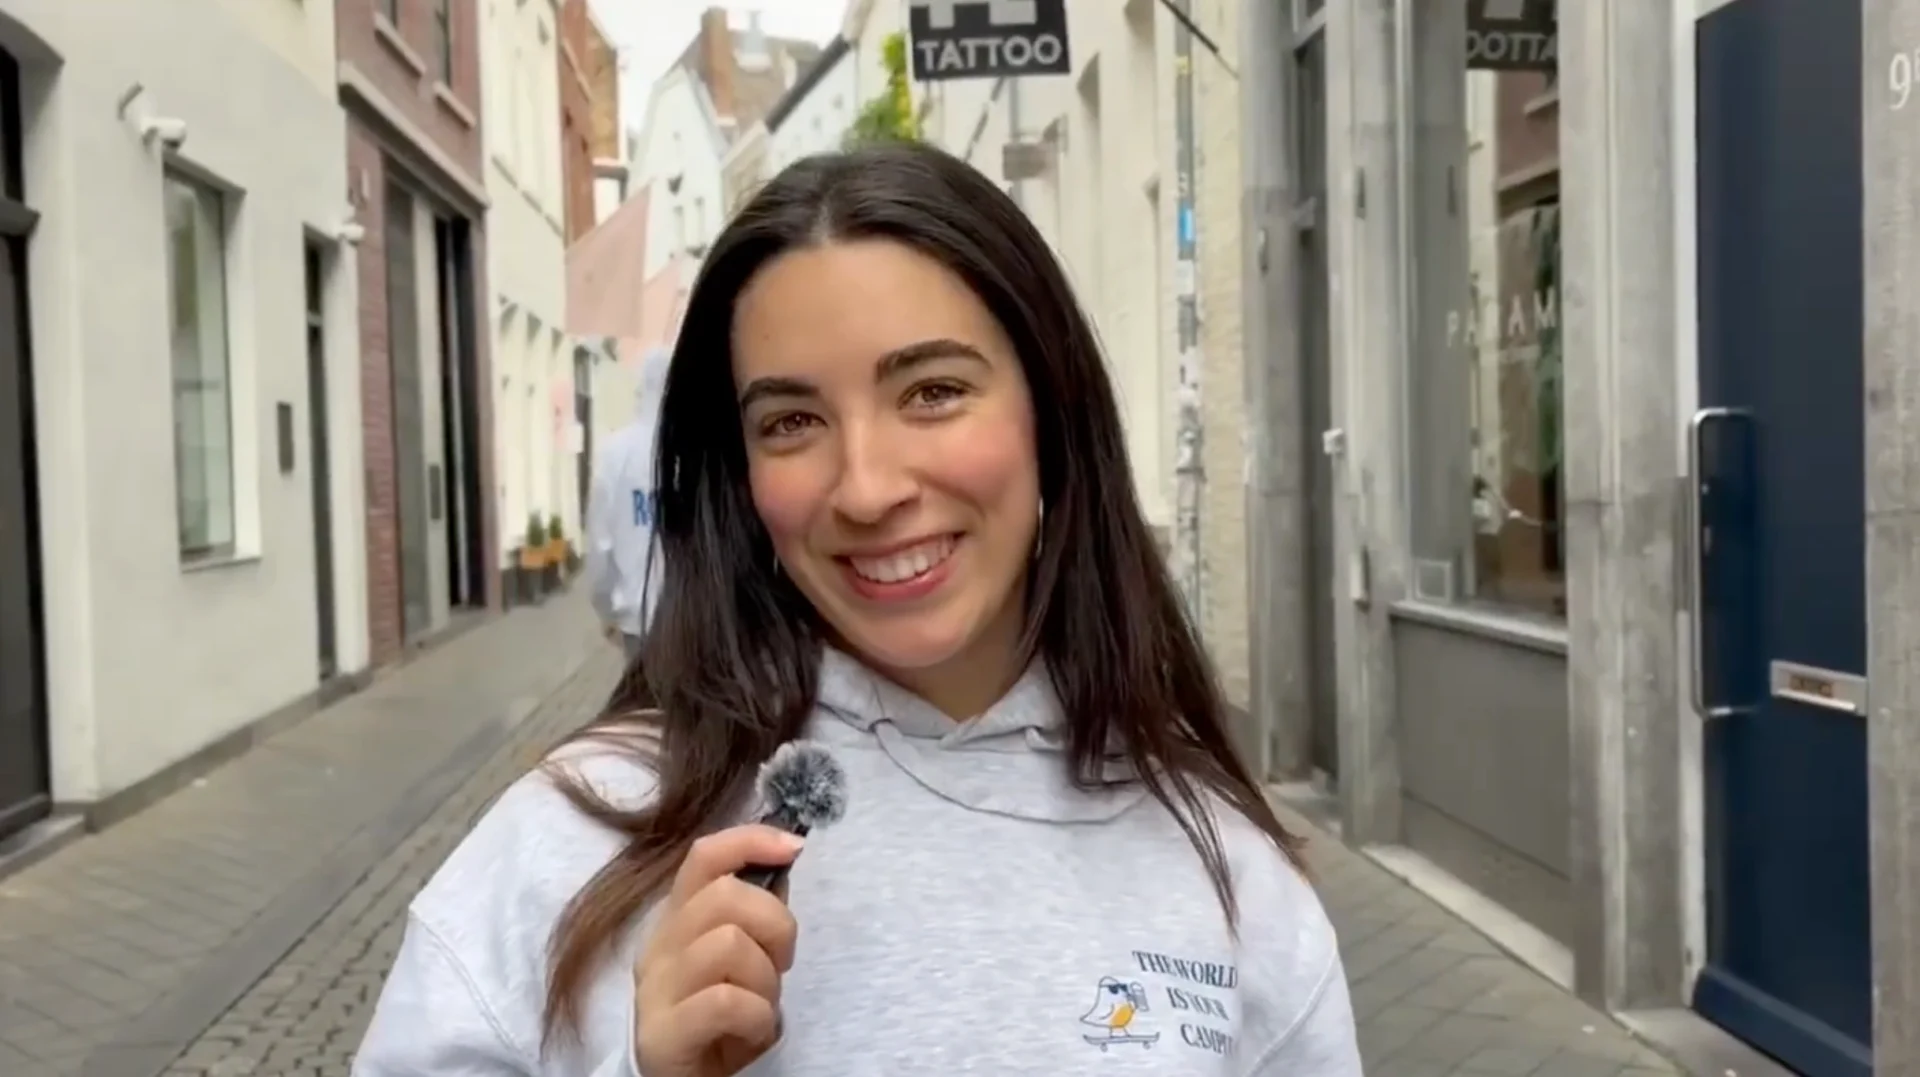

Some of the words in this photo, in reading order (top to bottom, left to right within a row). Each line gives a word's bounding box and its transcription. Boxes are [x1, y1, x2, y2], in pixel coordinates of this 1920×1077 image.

[916, 33, 1062, 72] TATTOO
[1132, 950, 1177, 977] THE
[1172, 958, 1238, 989] WORLD
[1165, 986, 1189, 1010] IS
